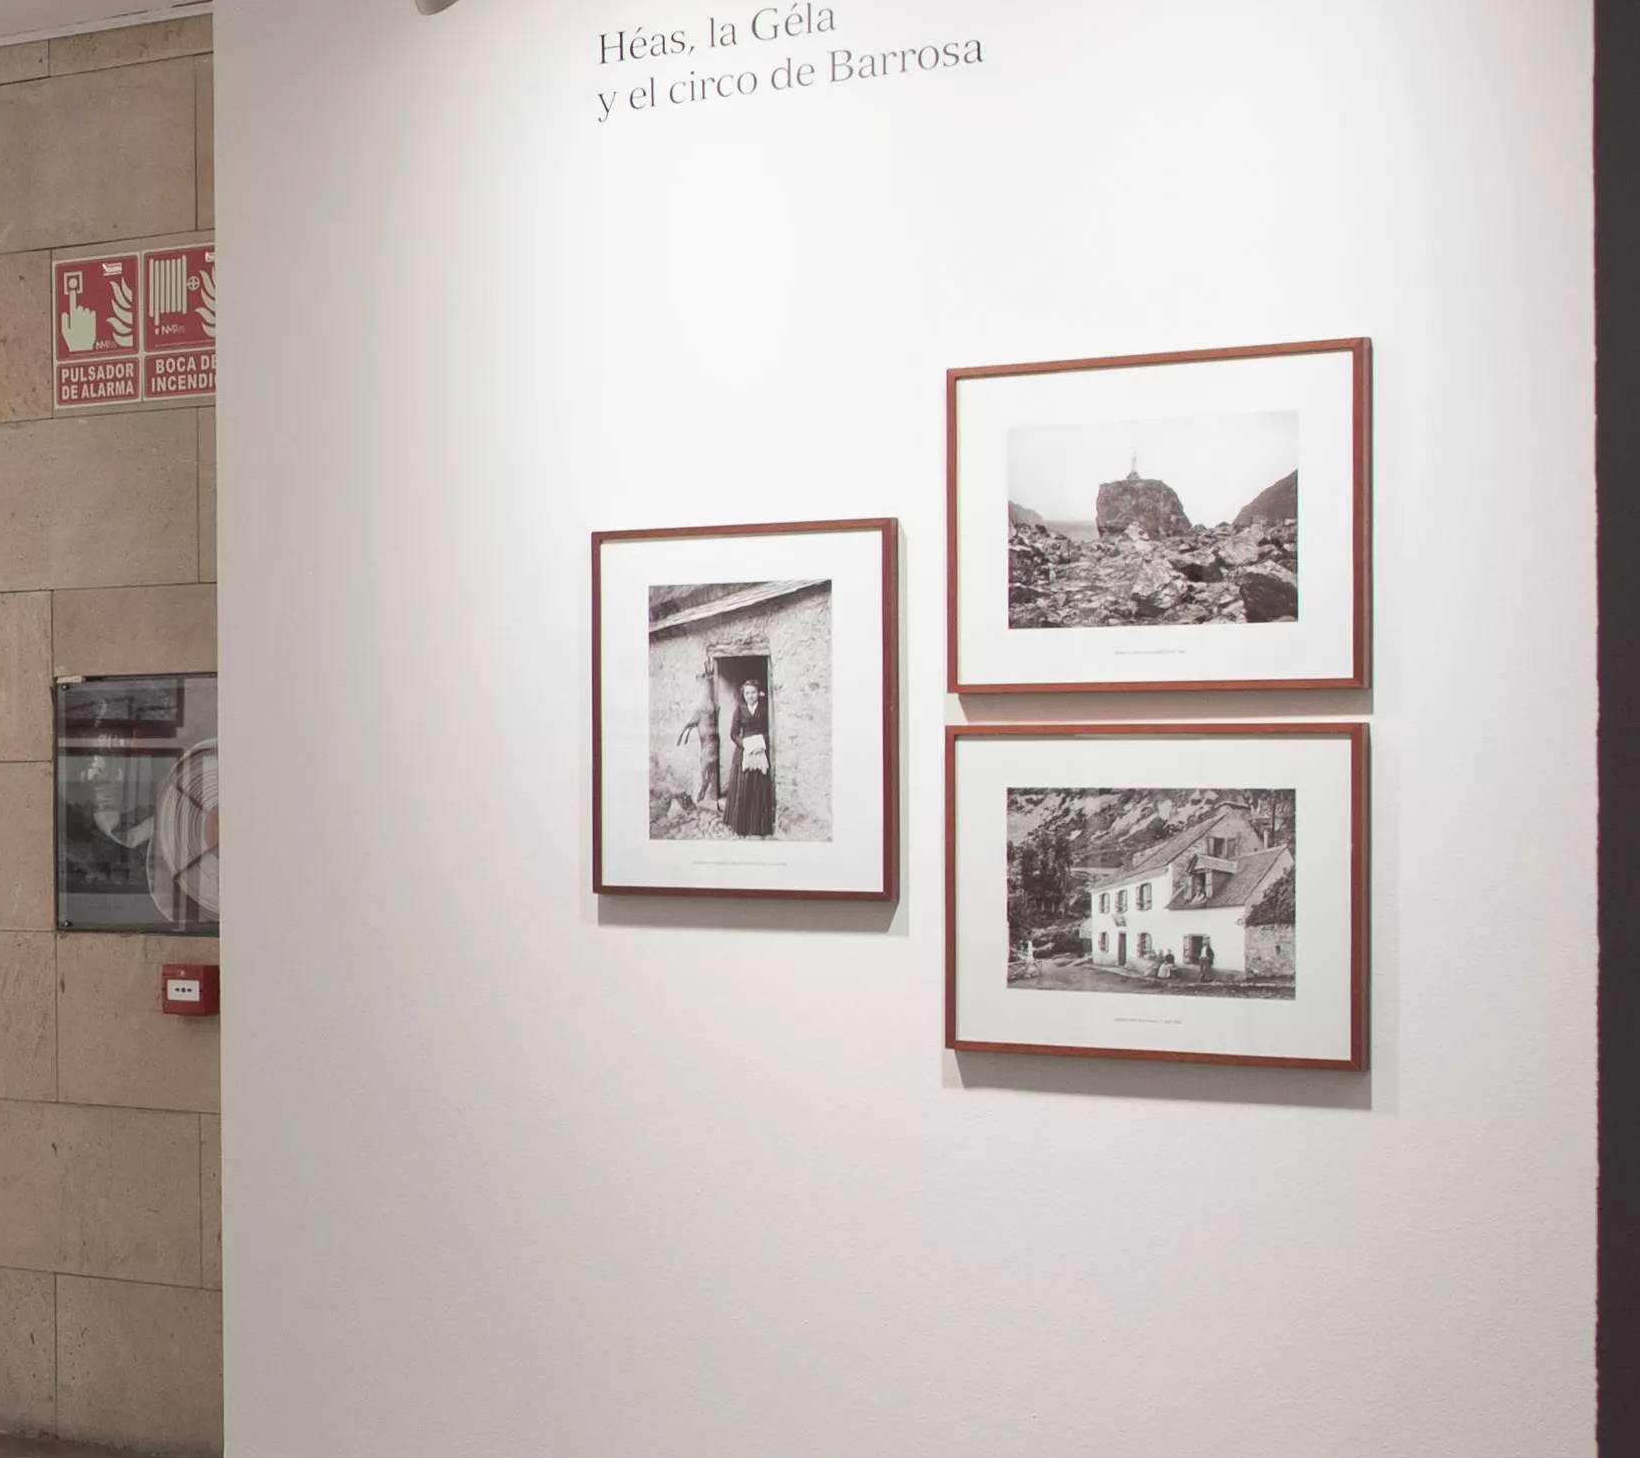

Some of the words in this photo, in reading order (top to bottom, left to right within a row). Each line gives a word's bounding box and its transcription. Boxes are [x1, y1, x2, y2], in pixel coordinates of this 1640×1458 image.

[597, 26, 695, 66] Héas,
[708, 17, 739, 49] la
[750, 2, 837, 42] Géla
[595, 89, 618, 124] y
[628, 76, 657, 111] el
[668, 70, 759, 107] circo
[769, 56, 817, 91] de
[828, 37, 986, 84] Barrosa
[61, 362, 135, 383] PULSADOR
[155, 355, 197, 374] BOCA
[62, 383, 79, 401] DE
[81, 380, 135, 399] ALARMA
[151, 372, 217, 393] INCENDI
